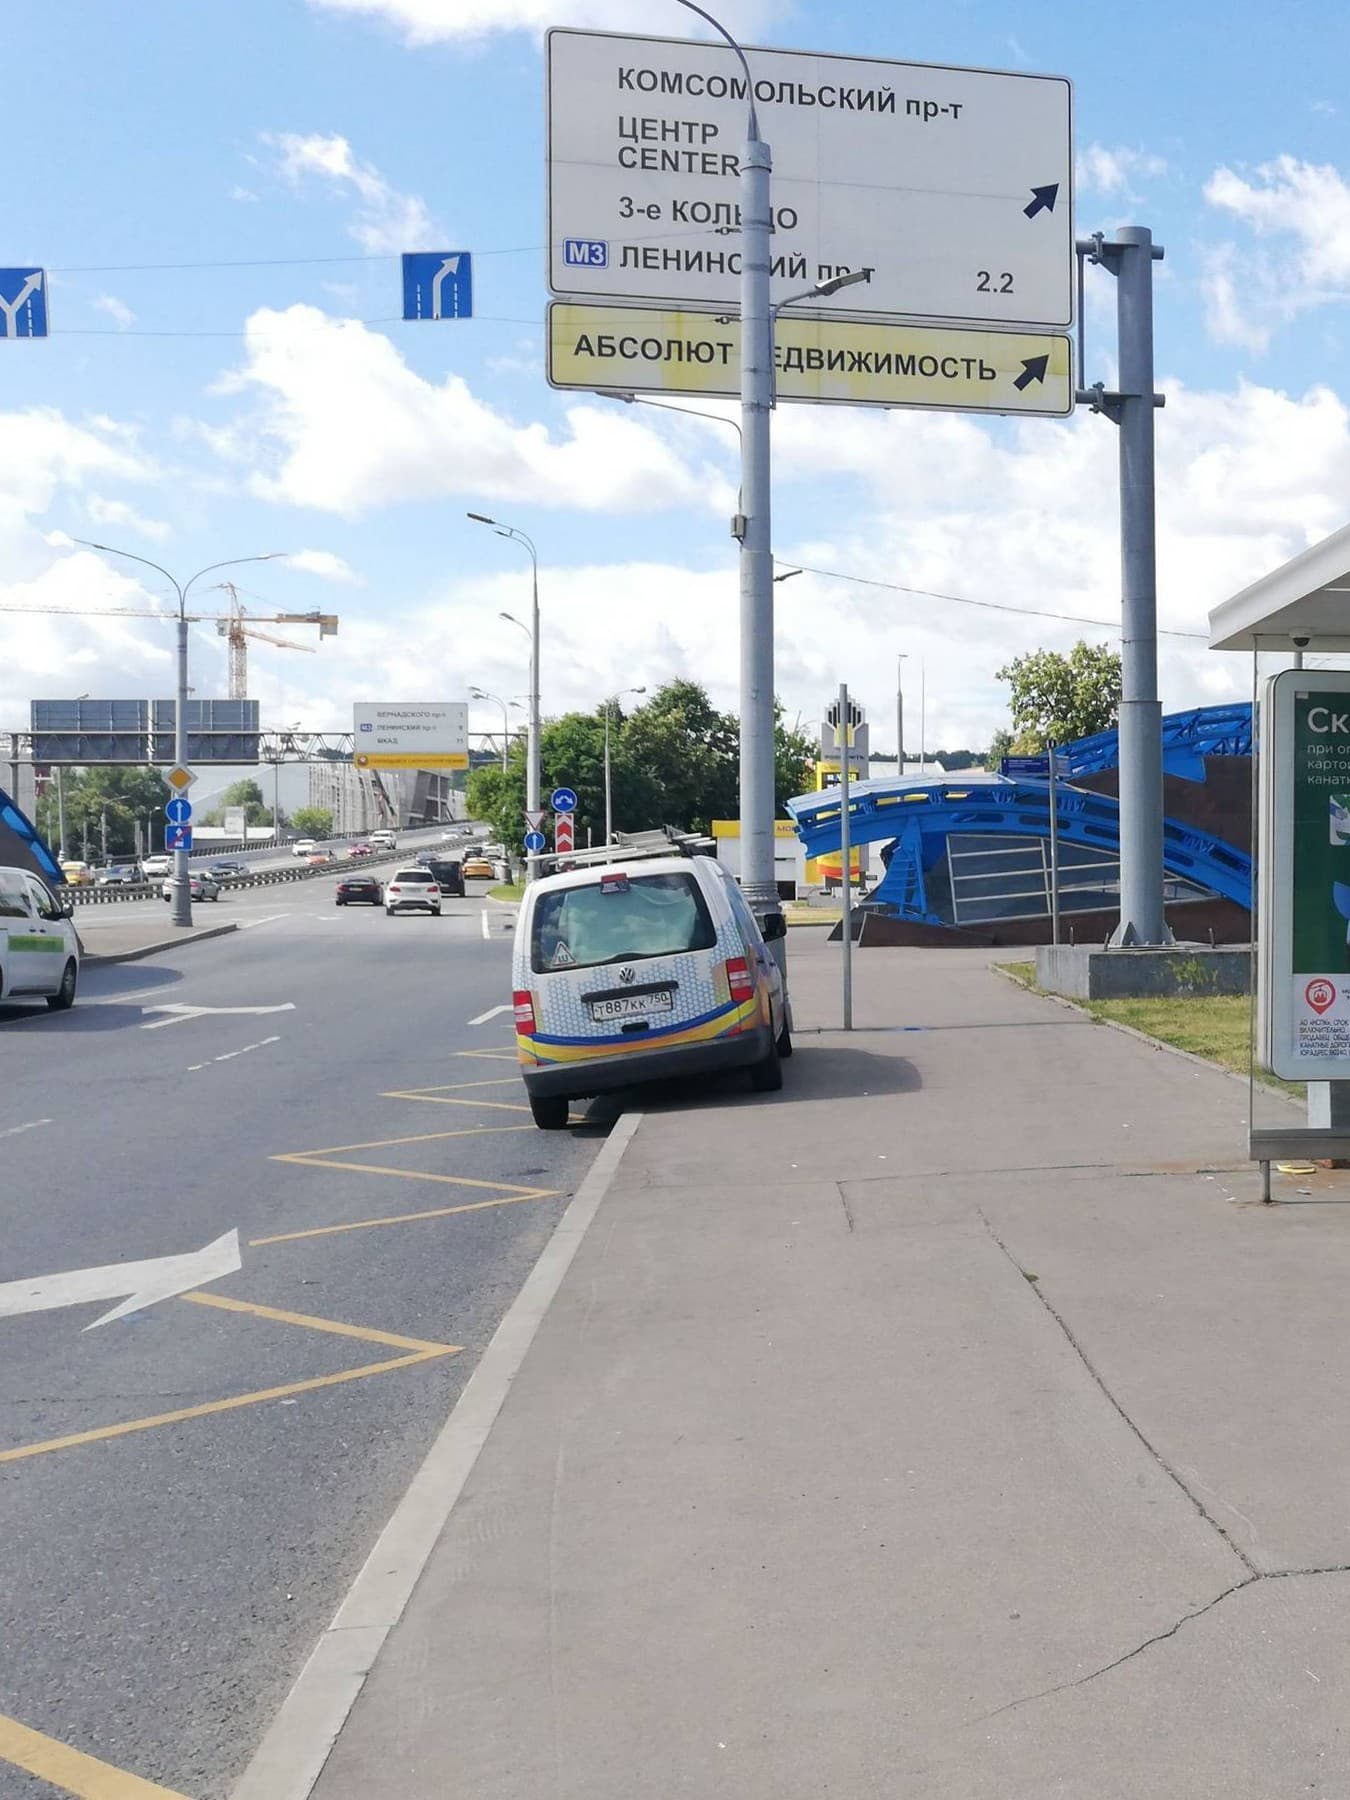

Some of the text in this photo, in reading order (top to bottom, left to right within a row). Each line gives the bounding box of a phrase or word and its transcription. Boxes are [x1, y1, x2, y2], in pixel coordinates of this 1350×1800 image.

[618, 66, 963, 121] КОМСОМОЛЬСКИЙ пр-т
[618, 115, 719, 145] ЦЕНТР
[618, 145, 741, 177] CENTER
[671, 199, 799, 231] КОЛО
[568, 241, 605, 265] М3
[619, 245, 807, 279] ЛЕНИНСИЙ
[976, 270, 1014, 295] 2.2
[573, 333, 998, 381] АБСОЛЮТ ДВИЖИМОСТЬ
[1307, 744, 1333, 757] при
